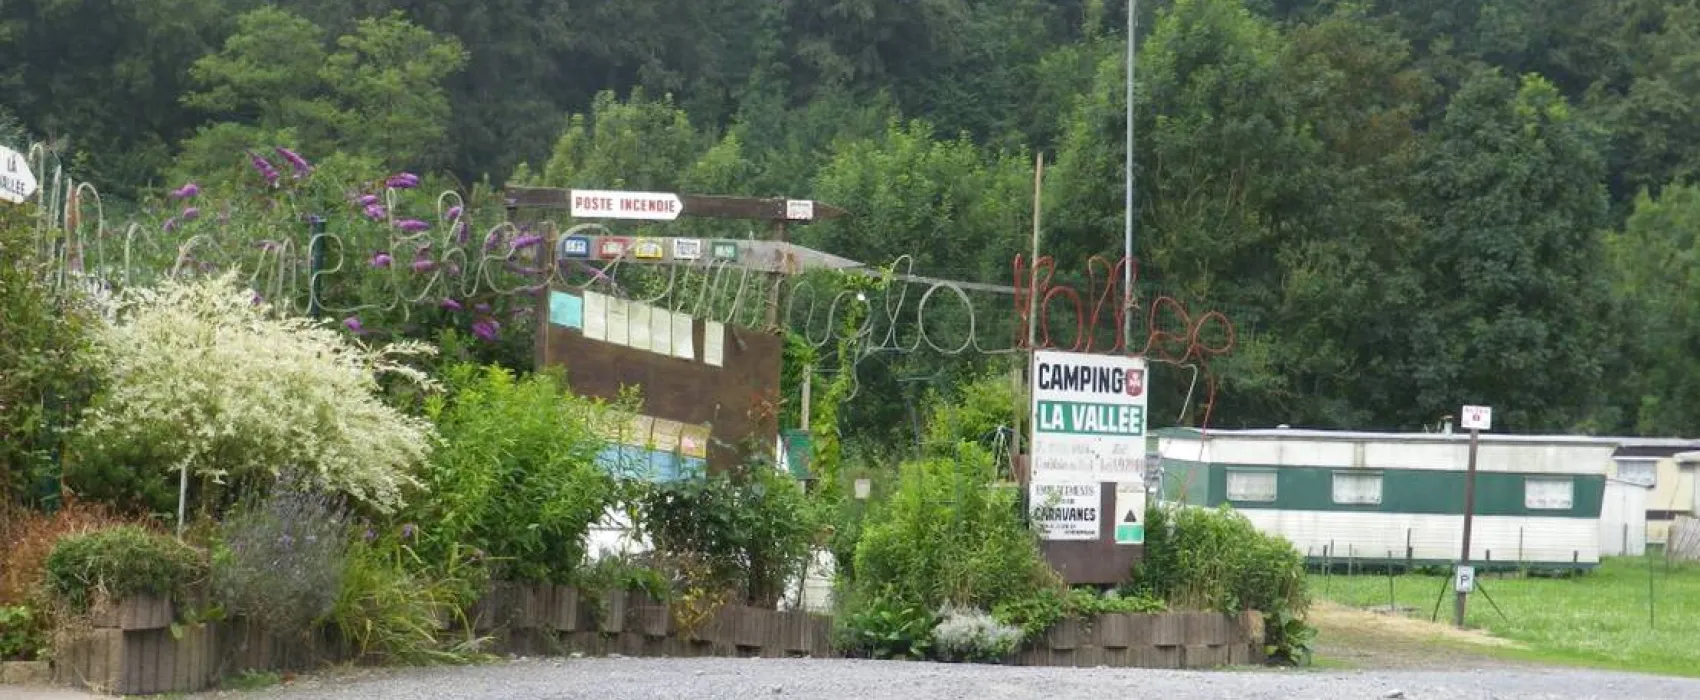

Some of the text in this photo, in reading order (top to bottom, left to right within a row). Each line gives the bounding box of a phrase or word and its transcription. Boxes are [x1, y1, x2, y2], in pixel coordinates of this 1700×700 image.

[0, 175, 25, 197] ALLEE
[575, 196, 675, 213] POSTE INCENDIE
[1039, 363, 1124, 394] CAMPING
[1040, 403, 1140, 434] LA VALLEE
[1034, 507, 1096, 521] CARAVANES
[1461, 575, 1470, 586] P
